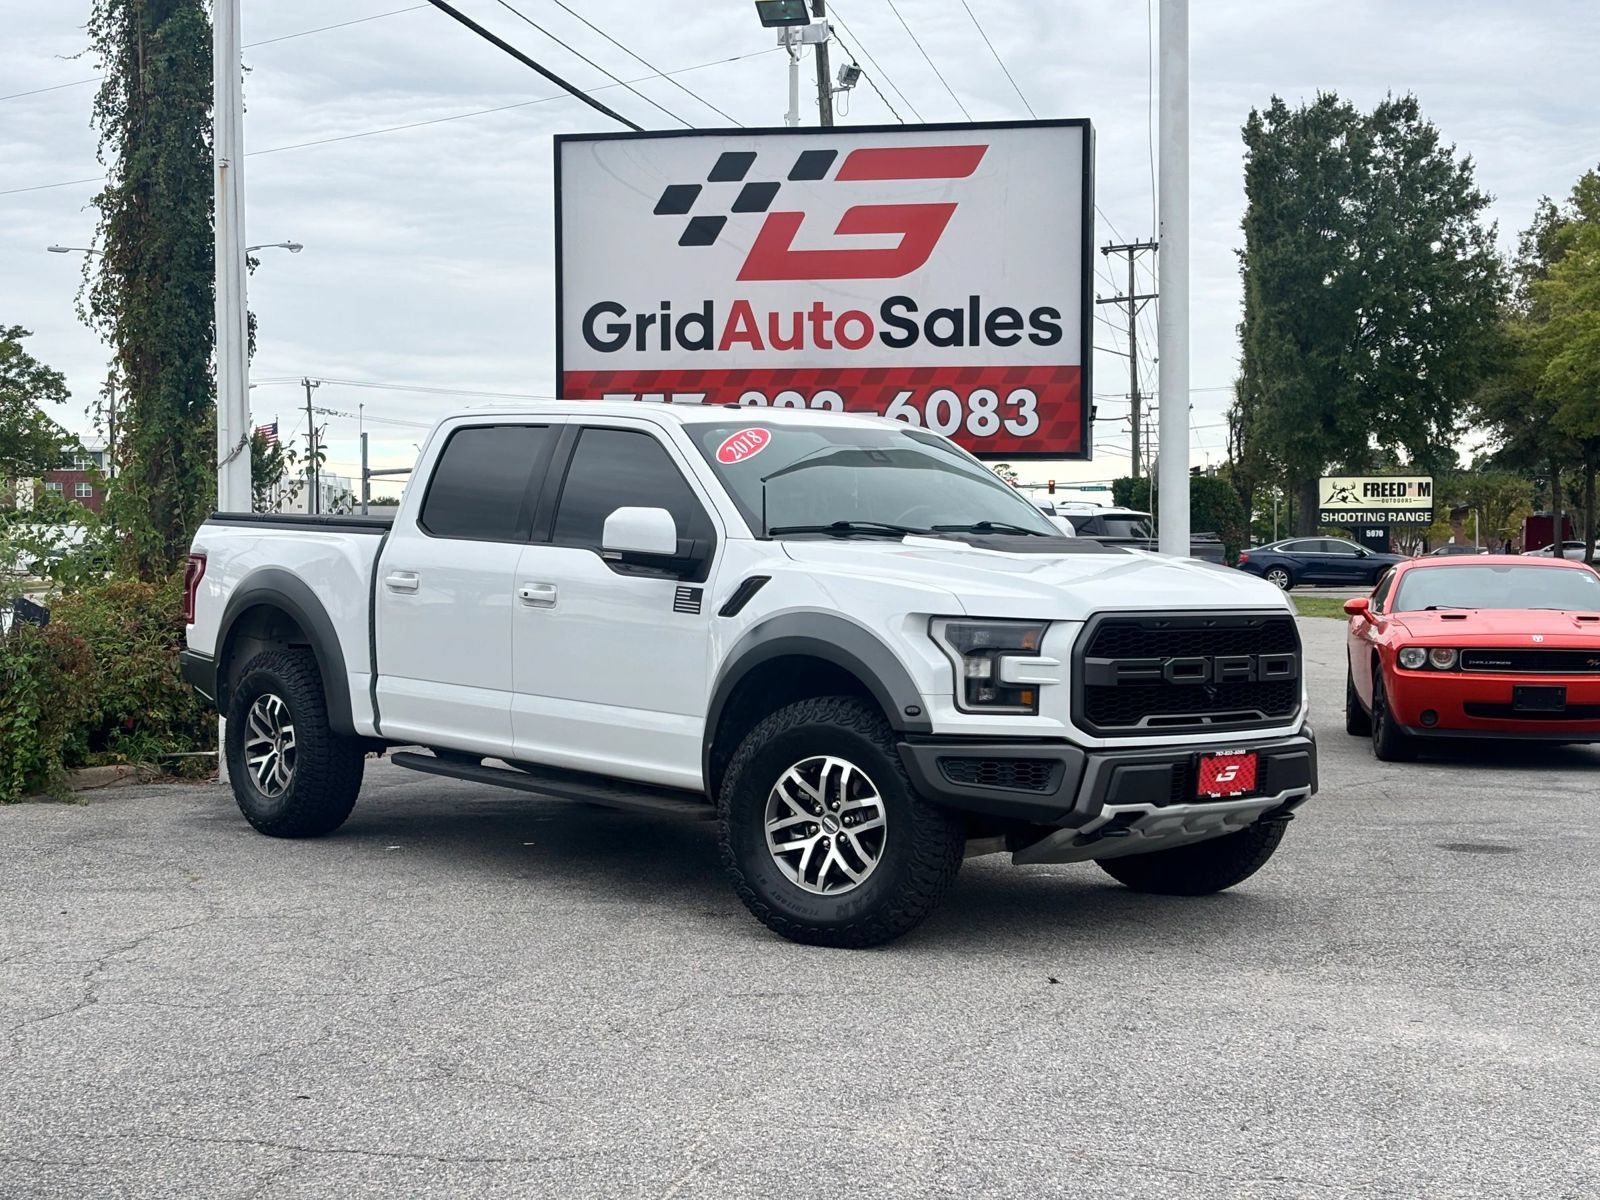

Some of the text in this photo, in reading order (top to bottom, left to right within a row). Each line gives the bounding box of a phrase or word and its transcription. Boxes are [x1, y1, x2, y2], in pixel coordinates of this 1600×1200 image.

[582, 295, 1063, 354] GridAutoSales
[726, 431, 762, 460] 2018
[1363, 482, 1431, 497] FREEDM
[1321, 512, 1432, 522] SHOOTING RANGE
[1106, 653, 1299, 686] FORD
